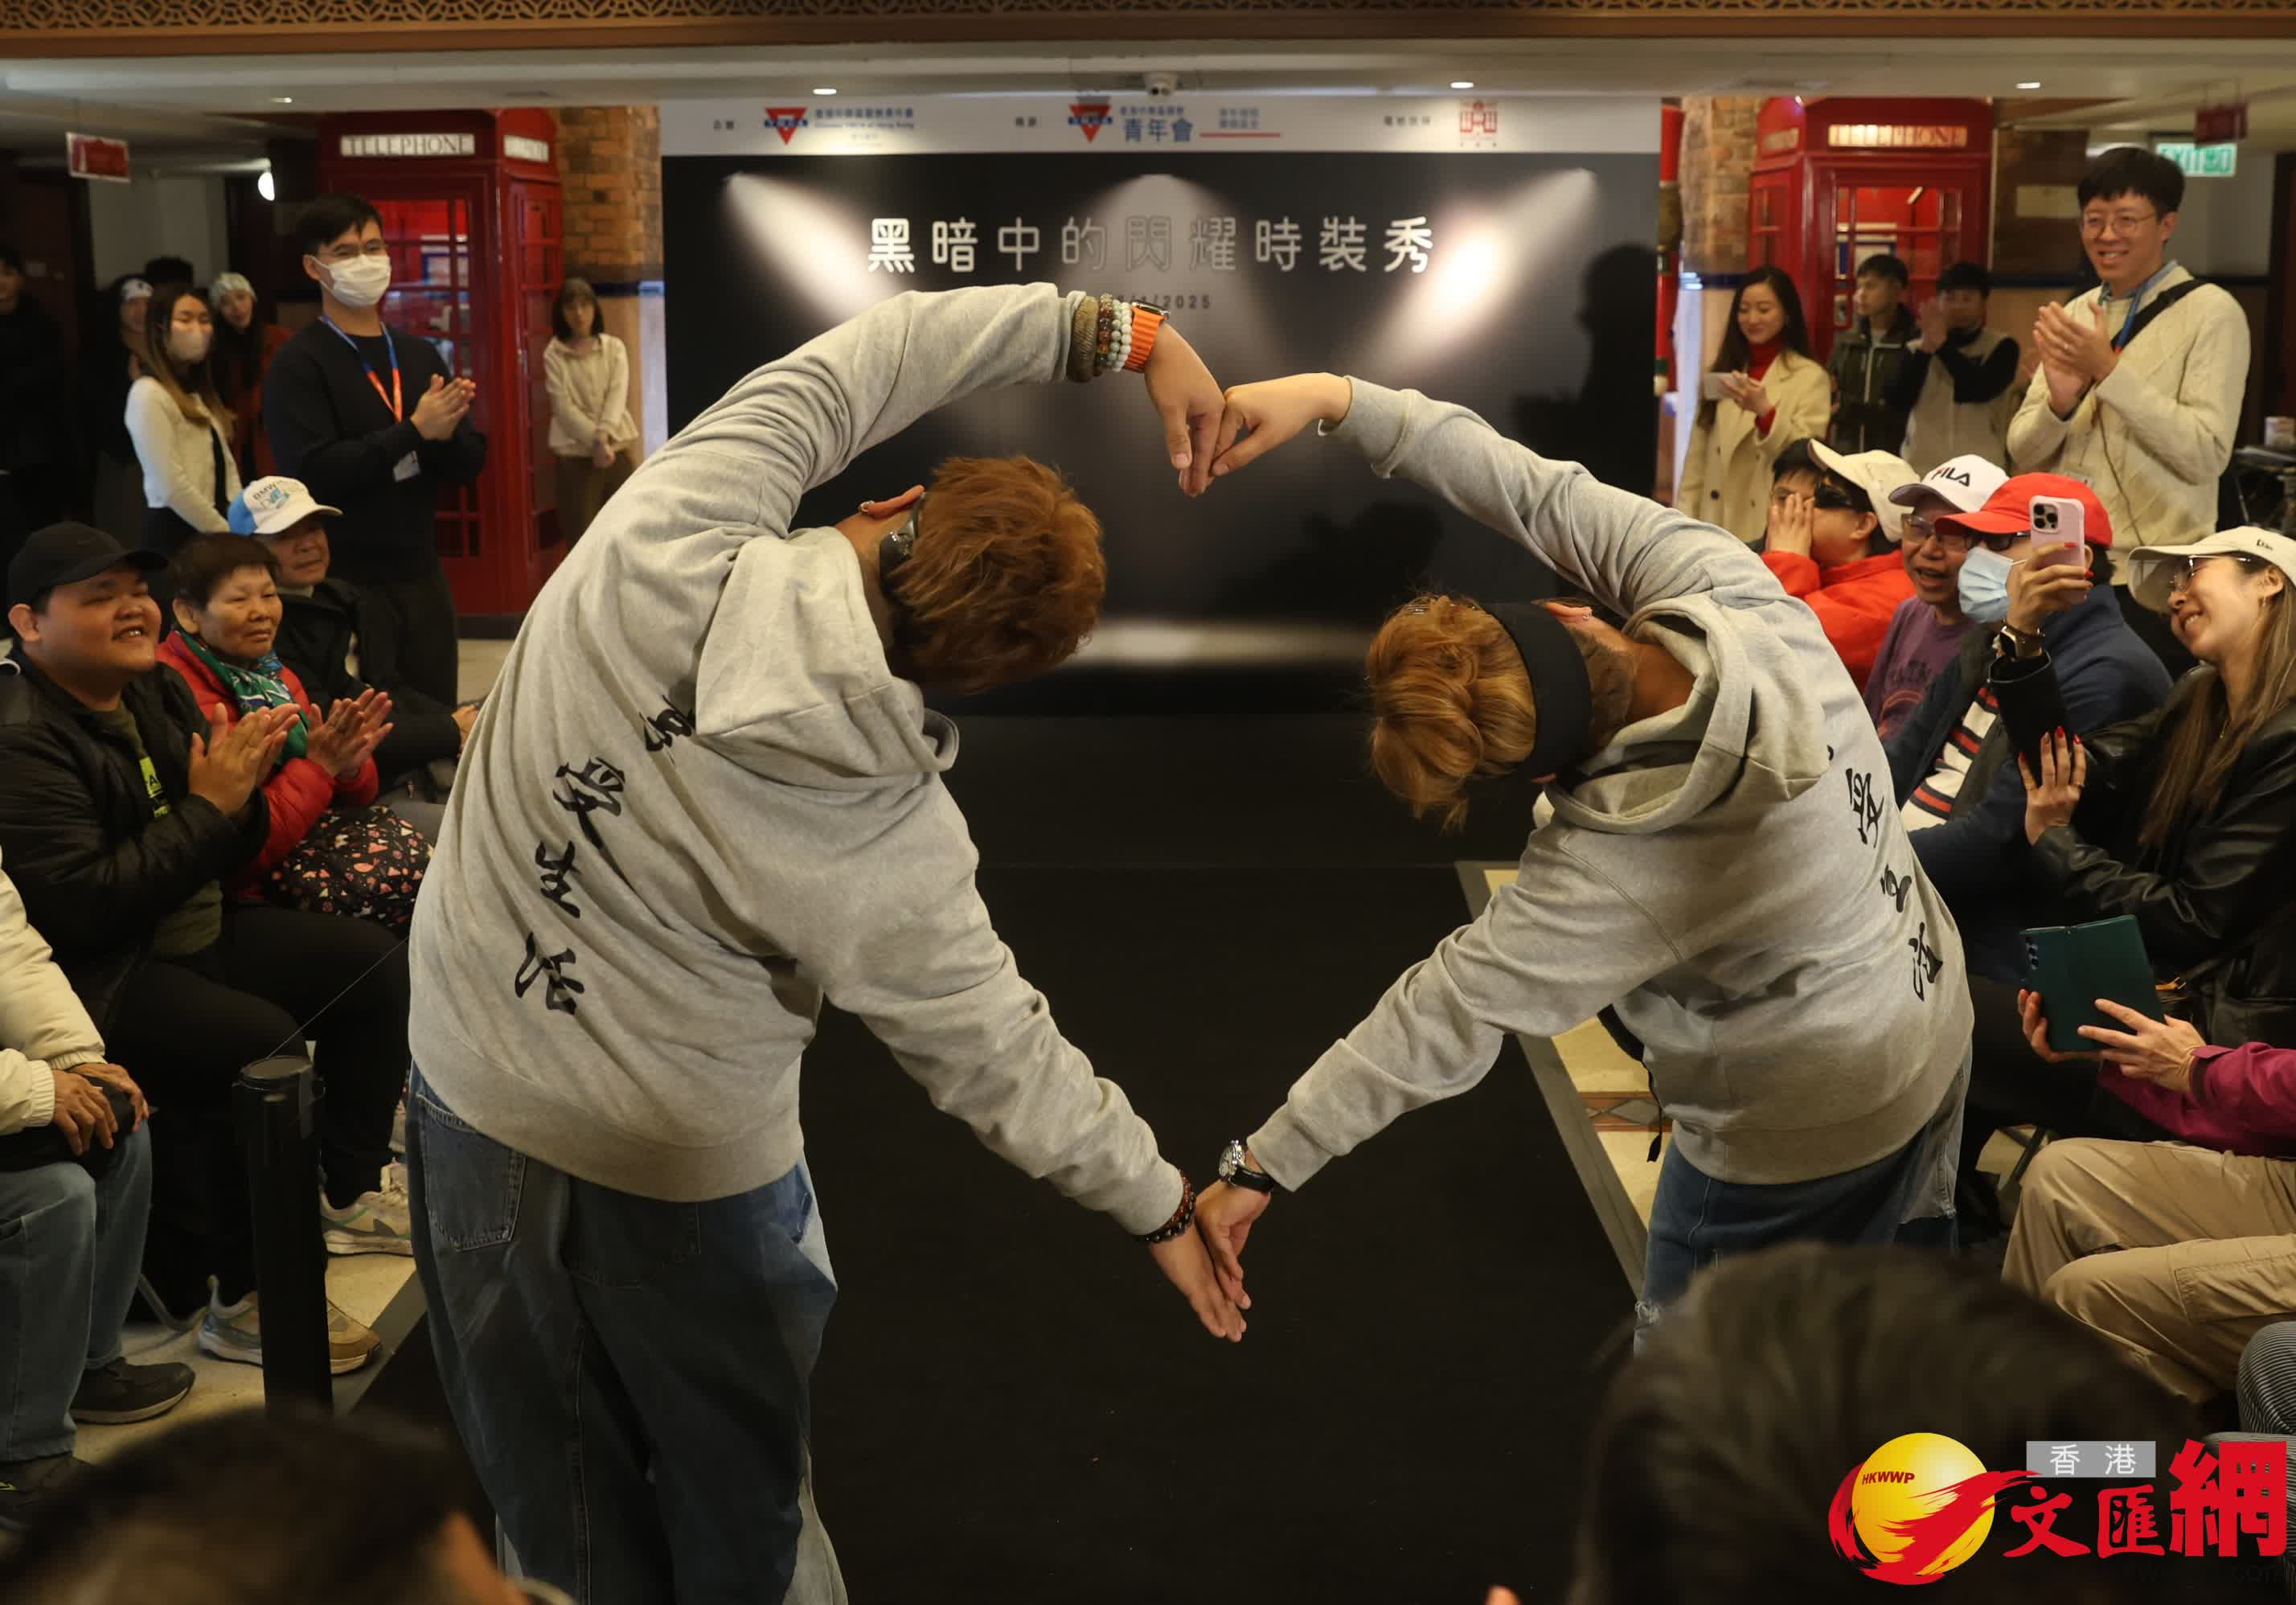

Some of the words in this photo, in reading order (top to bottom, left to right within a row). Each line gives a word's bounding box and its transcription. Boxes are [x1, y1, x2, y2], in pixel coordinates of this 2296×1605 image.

[346, 134, 467, 154] TELEPHONE
[867, 215, 1433, 274] 黑暗中的閃耀時裝秀
[1931, 466, 1970, 487] FILA
